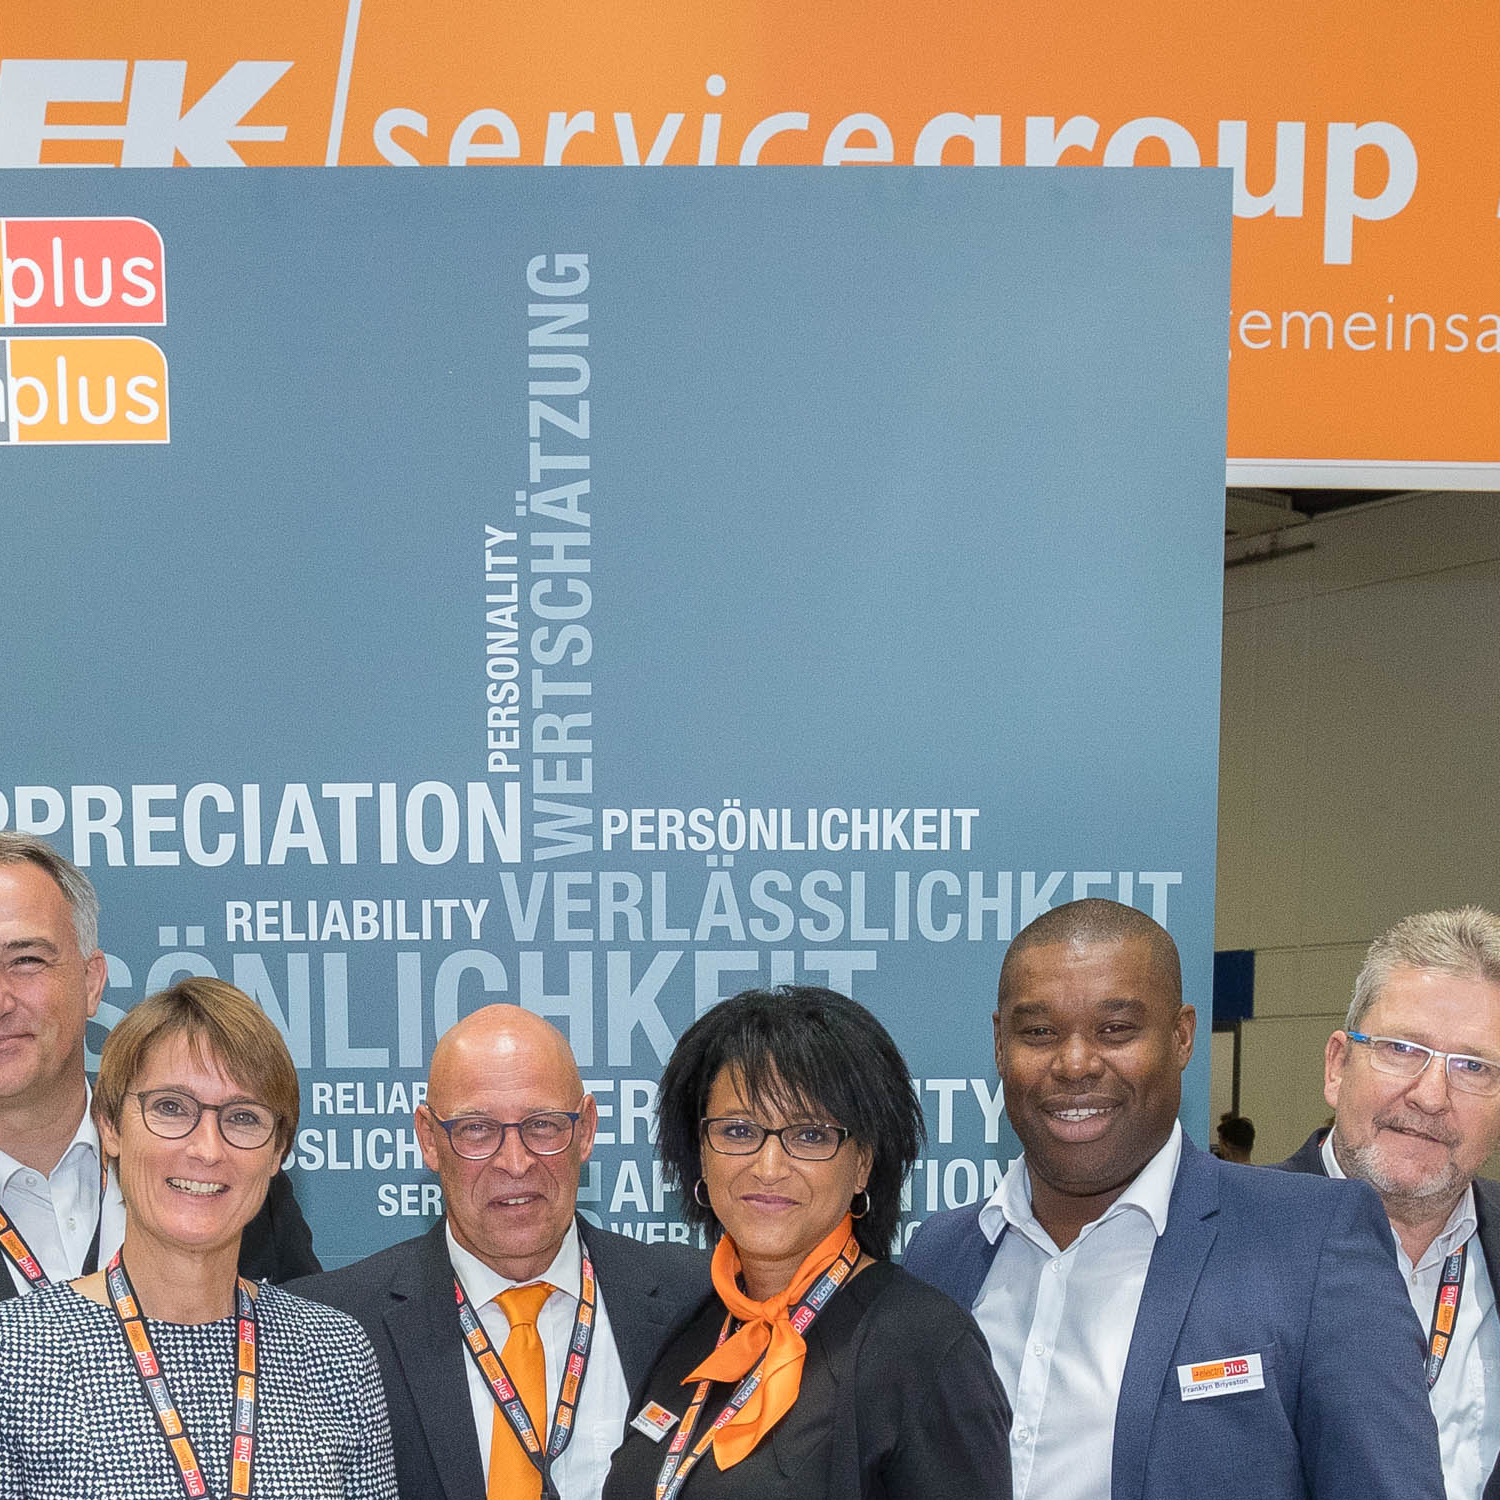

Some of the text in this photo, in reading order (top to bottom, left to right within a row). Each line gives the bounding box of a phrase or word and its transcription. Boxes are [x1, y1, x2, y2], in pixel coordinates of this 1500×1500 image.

[515, 252, 594, 861] WERTSCHÄTZUNG
[484, 523, 520, 773] PERSONALITY
[601, 798, 980, 852] PERSÖNLICHKEIT
[225, 898, 490, 943] RELIABILITY
